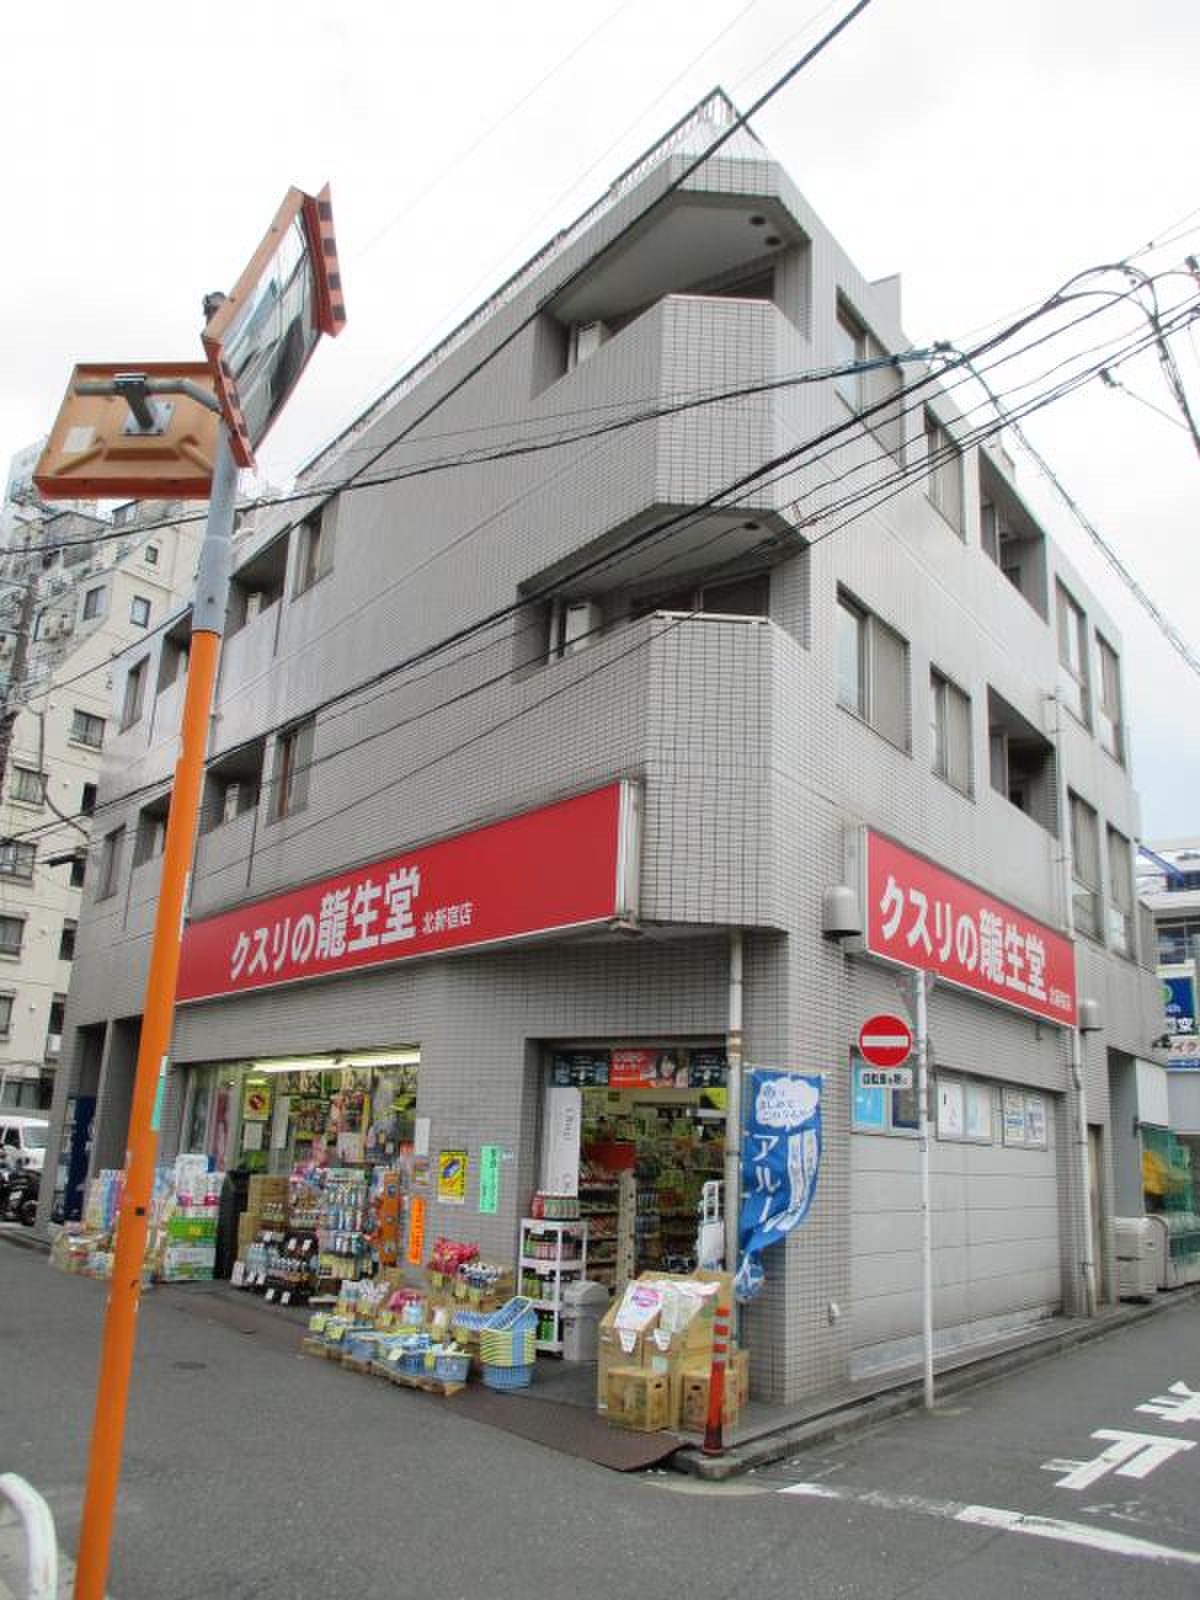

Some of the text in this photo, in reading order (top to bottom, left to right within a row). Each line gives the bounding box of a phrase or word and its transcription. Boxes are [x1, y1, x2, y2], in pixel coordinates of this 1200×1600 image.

[229, 865, 421, 982] クスリの龍生堂
[879, 875, 1047, 1002] クスリの龍生堂
